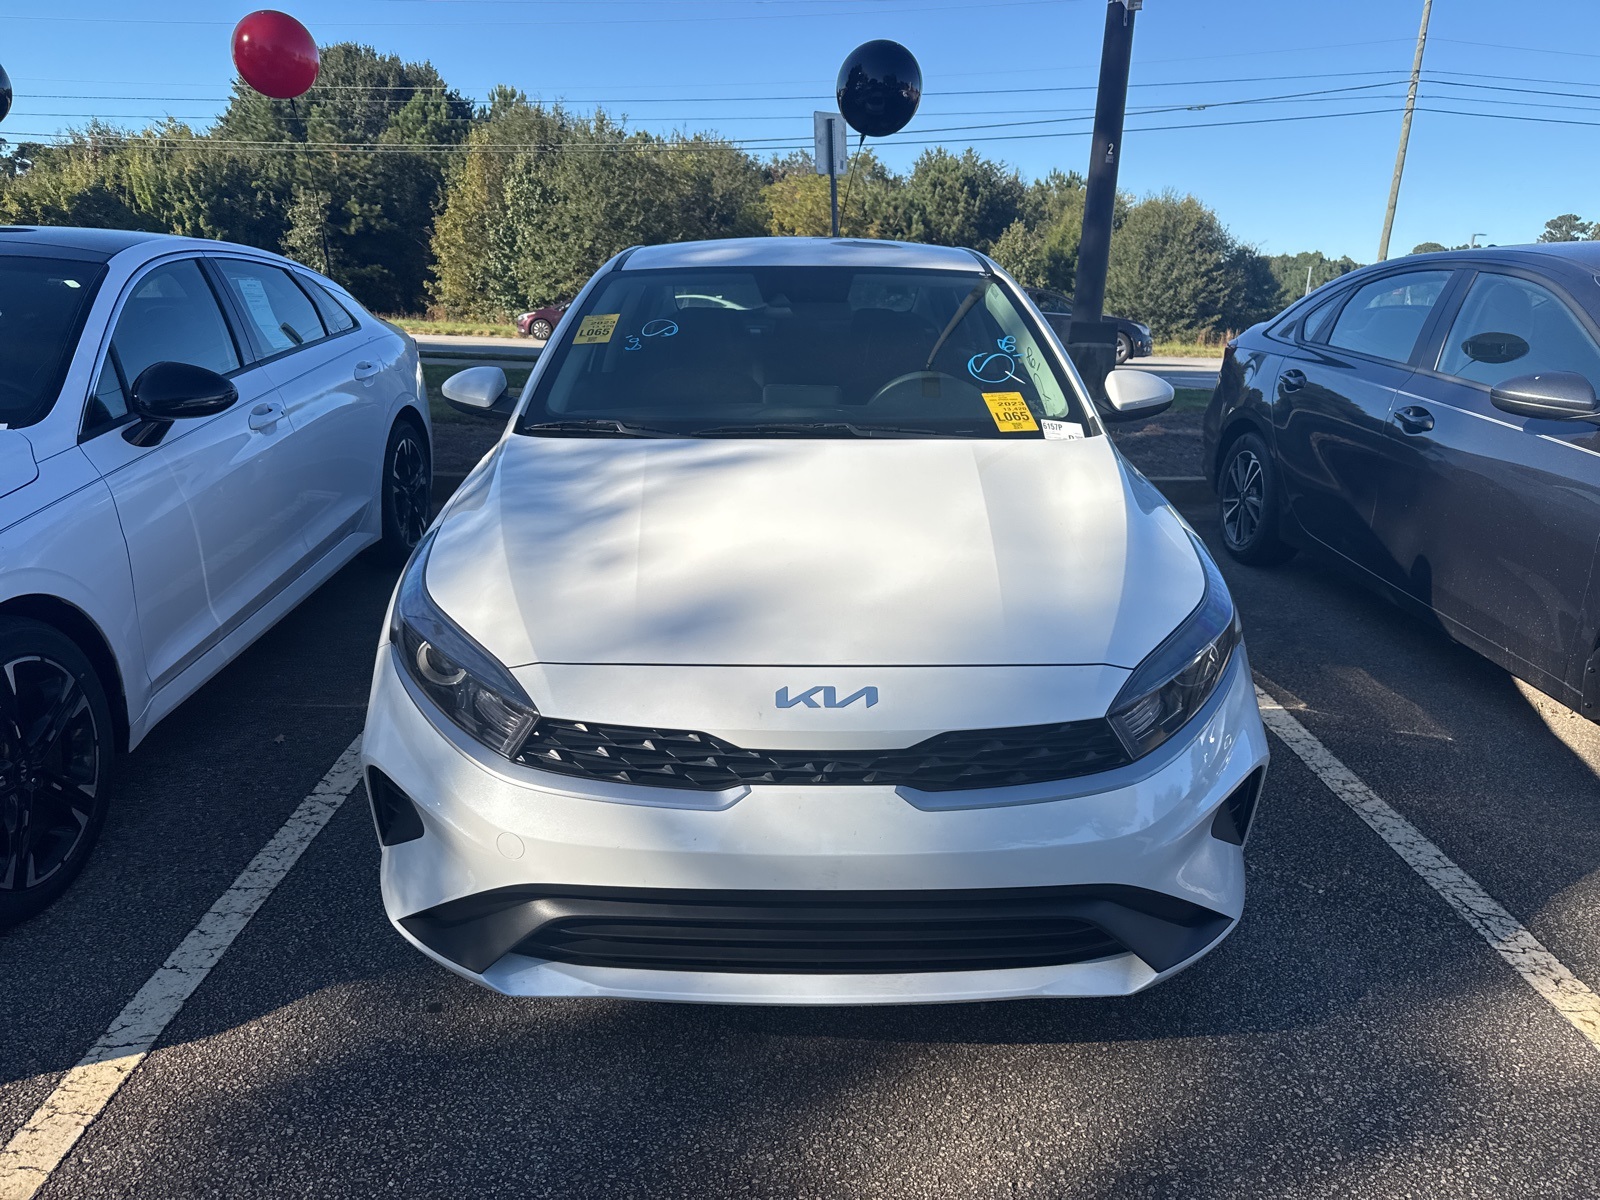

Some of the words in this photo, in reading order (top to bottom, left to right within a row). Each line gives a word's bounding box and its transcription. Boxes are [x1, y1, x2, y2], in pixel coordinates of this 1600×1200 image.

[1107, 142, 1114, 155] 2
[579, 328, 610, 337] L065
[995, 411, 1030, 422] L065
[775, 686, 879, 708] KIA
